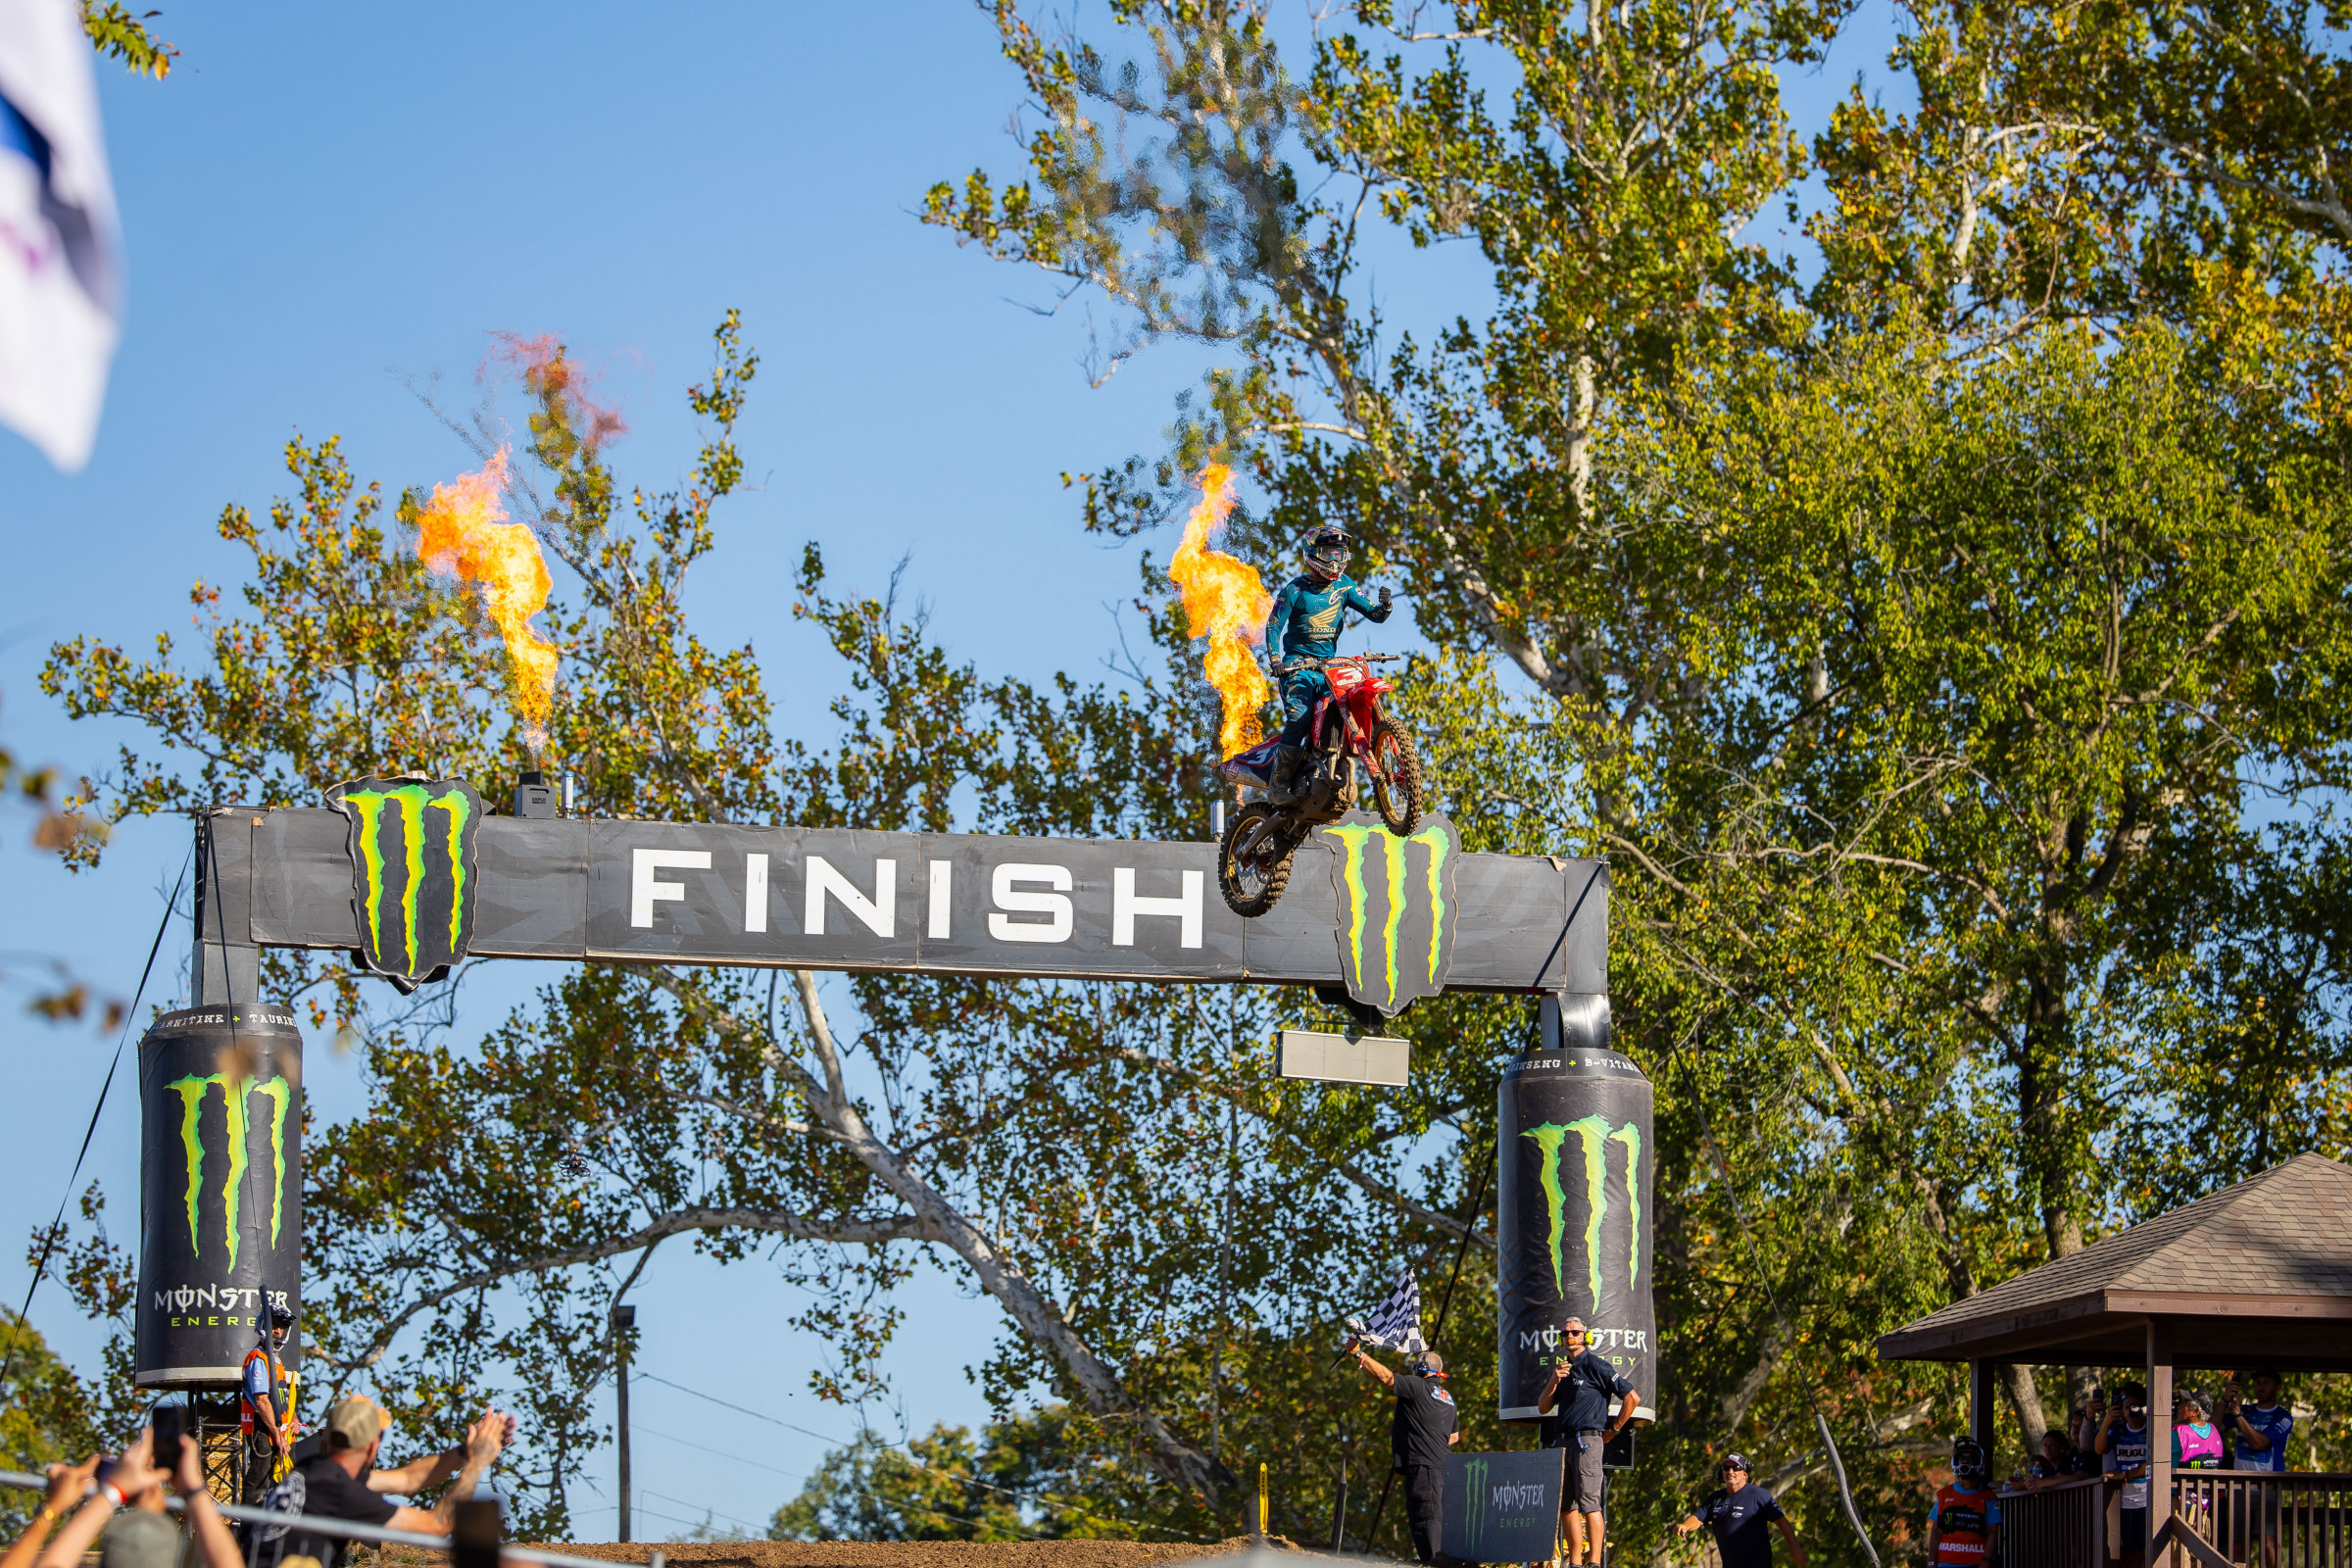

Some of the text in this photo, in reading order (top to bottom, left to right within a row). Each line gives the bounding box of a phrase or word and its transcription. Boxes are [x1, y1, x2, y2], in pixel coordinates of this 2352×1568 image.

[1336, 666, 1363, 687] 3
[1248, 748, 1271, 764] 3
[630, 848, 1204, 949] FINISH
[158, 1014, 225, 1029] ARNITINE
[172, 1316, 257, 1327] ENERG
[1519, 1324, 1648, 1353] MOSTER
[1493, 1480, 1544, 1512] MONSTER
[1499, 1517, 1537, 1528] ENERGY
[1937, 1542, 1985, 1553] MARSHALL
